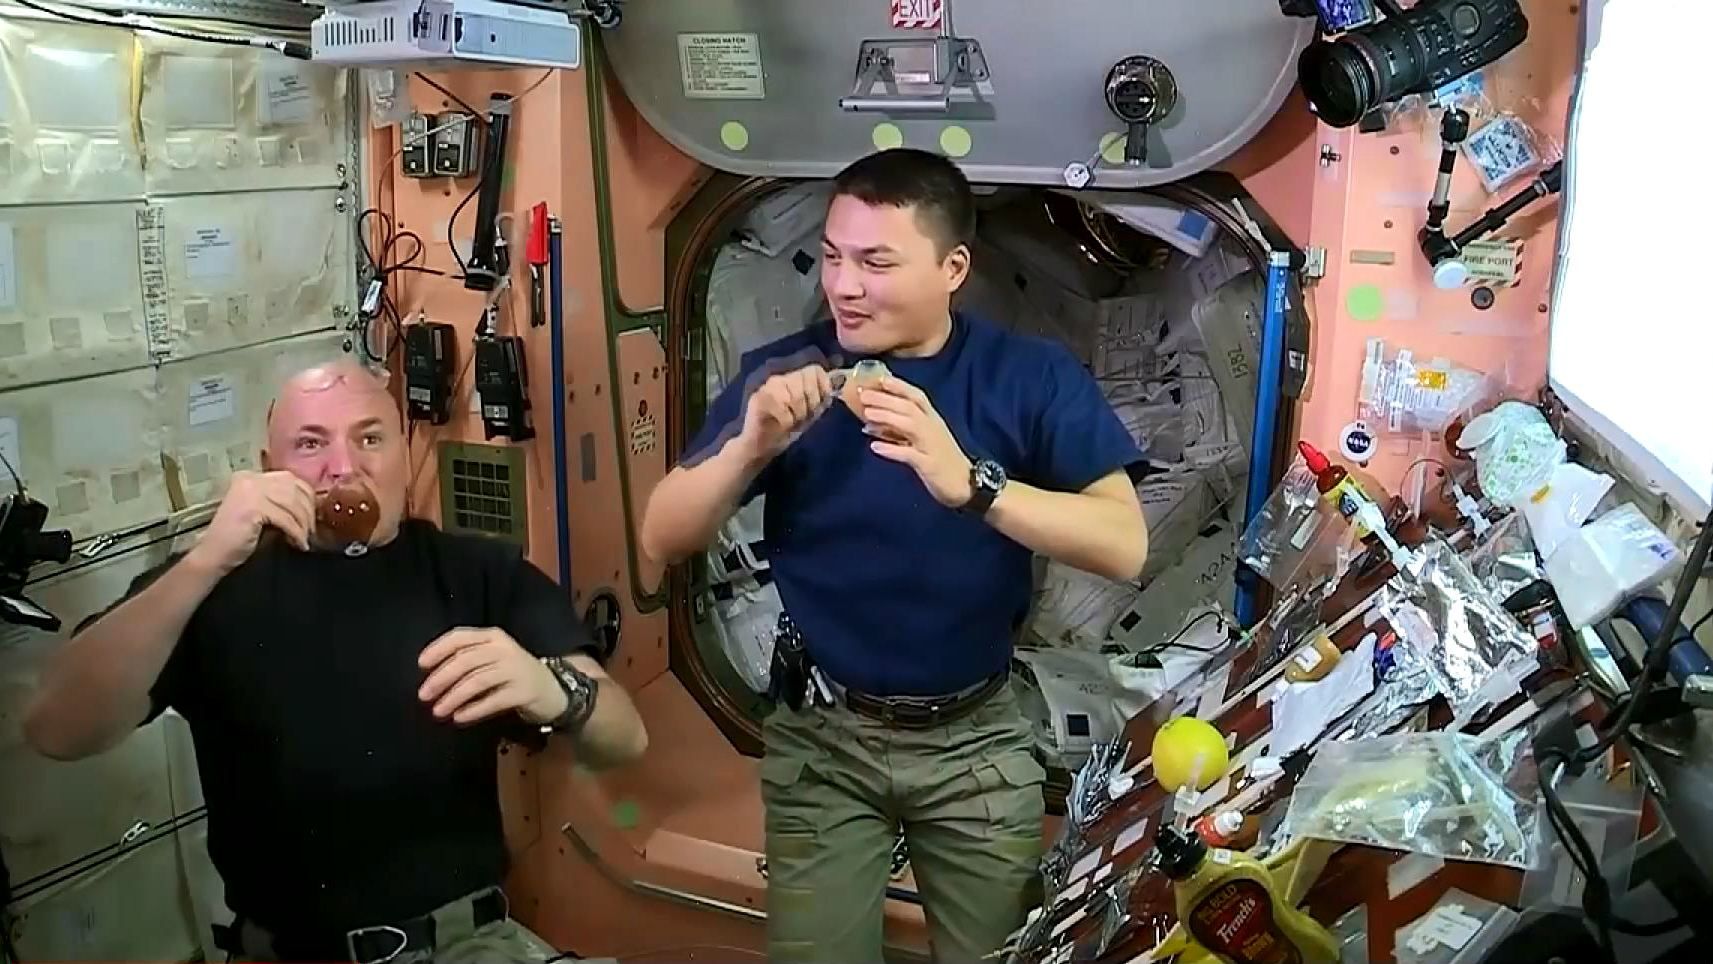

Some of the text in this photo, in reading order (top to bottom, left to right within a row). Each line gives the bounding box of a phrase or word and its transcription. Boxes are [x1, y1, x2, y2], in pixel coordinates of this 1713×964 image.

[1464, 254, 1513, 267] FIRE PORT
[1347, 437, 1369, 449] NASA
